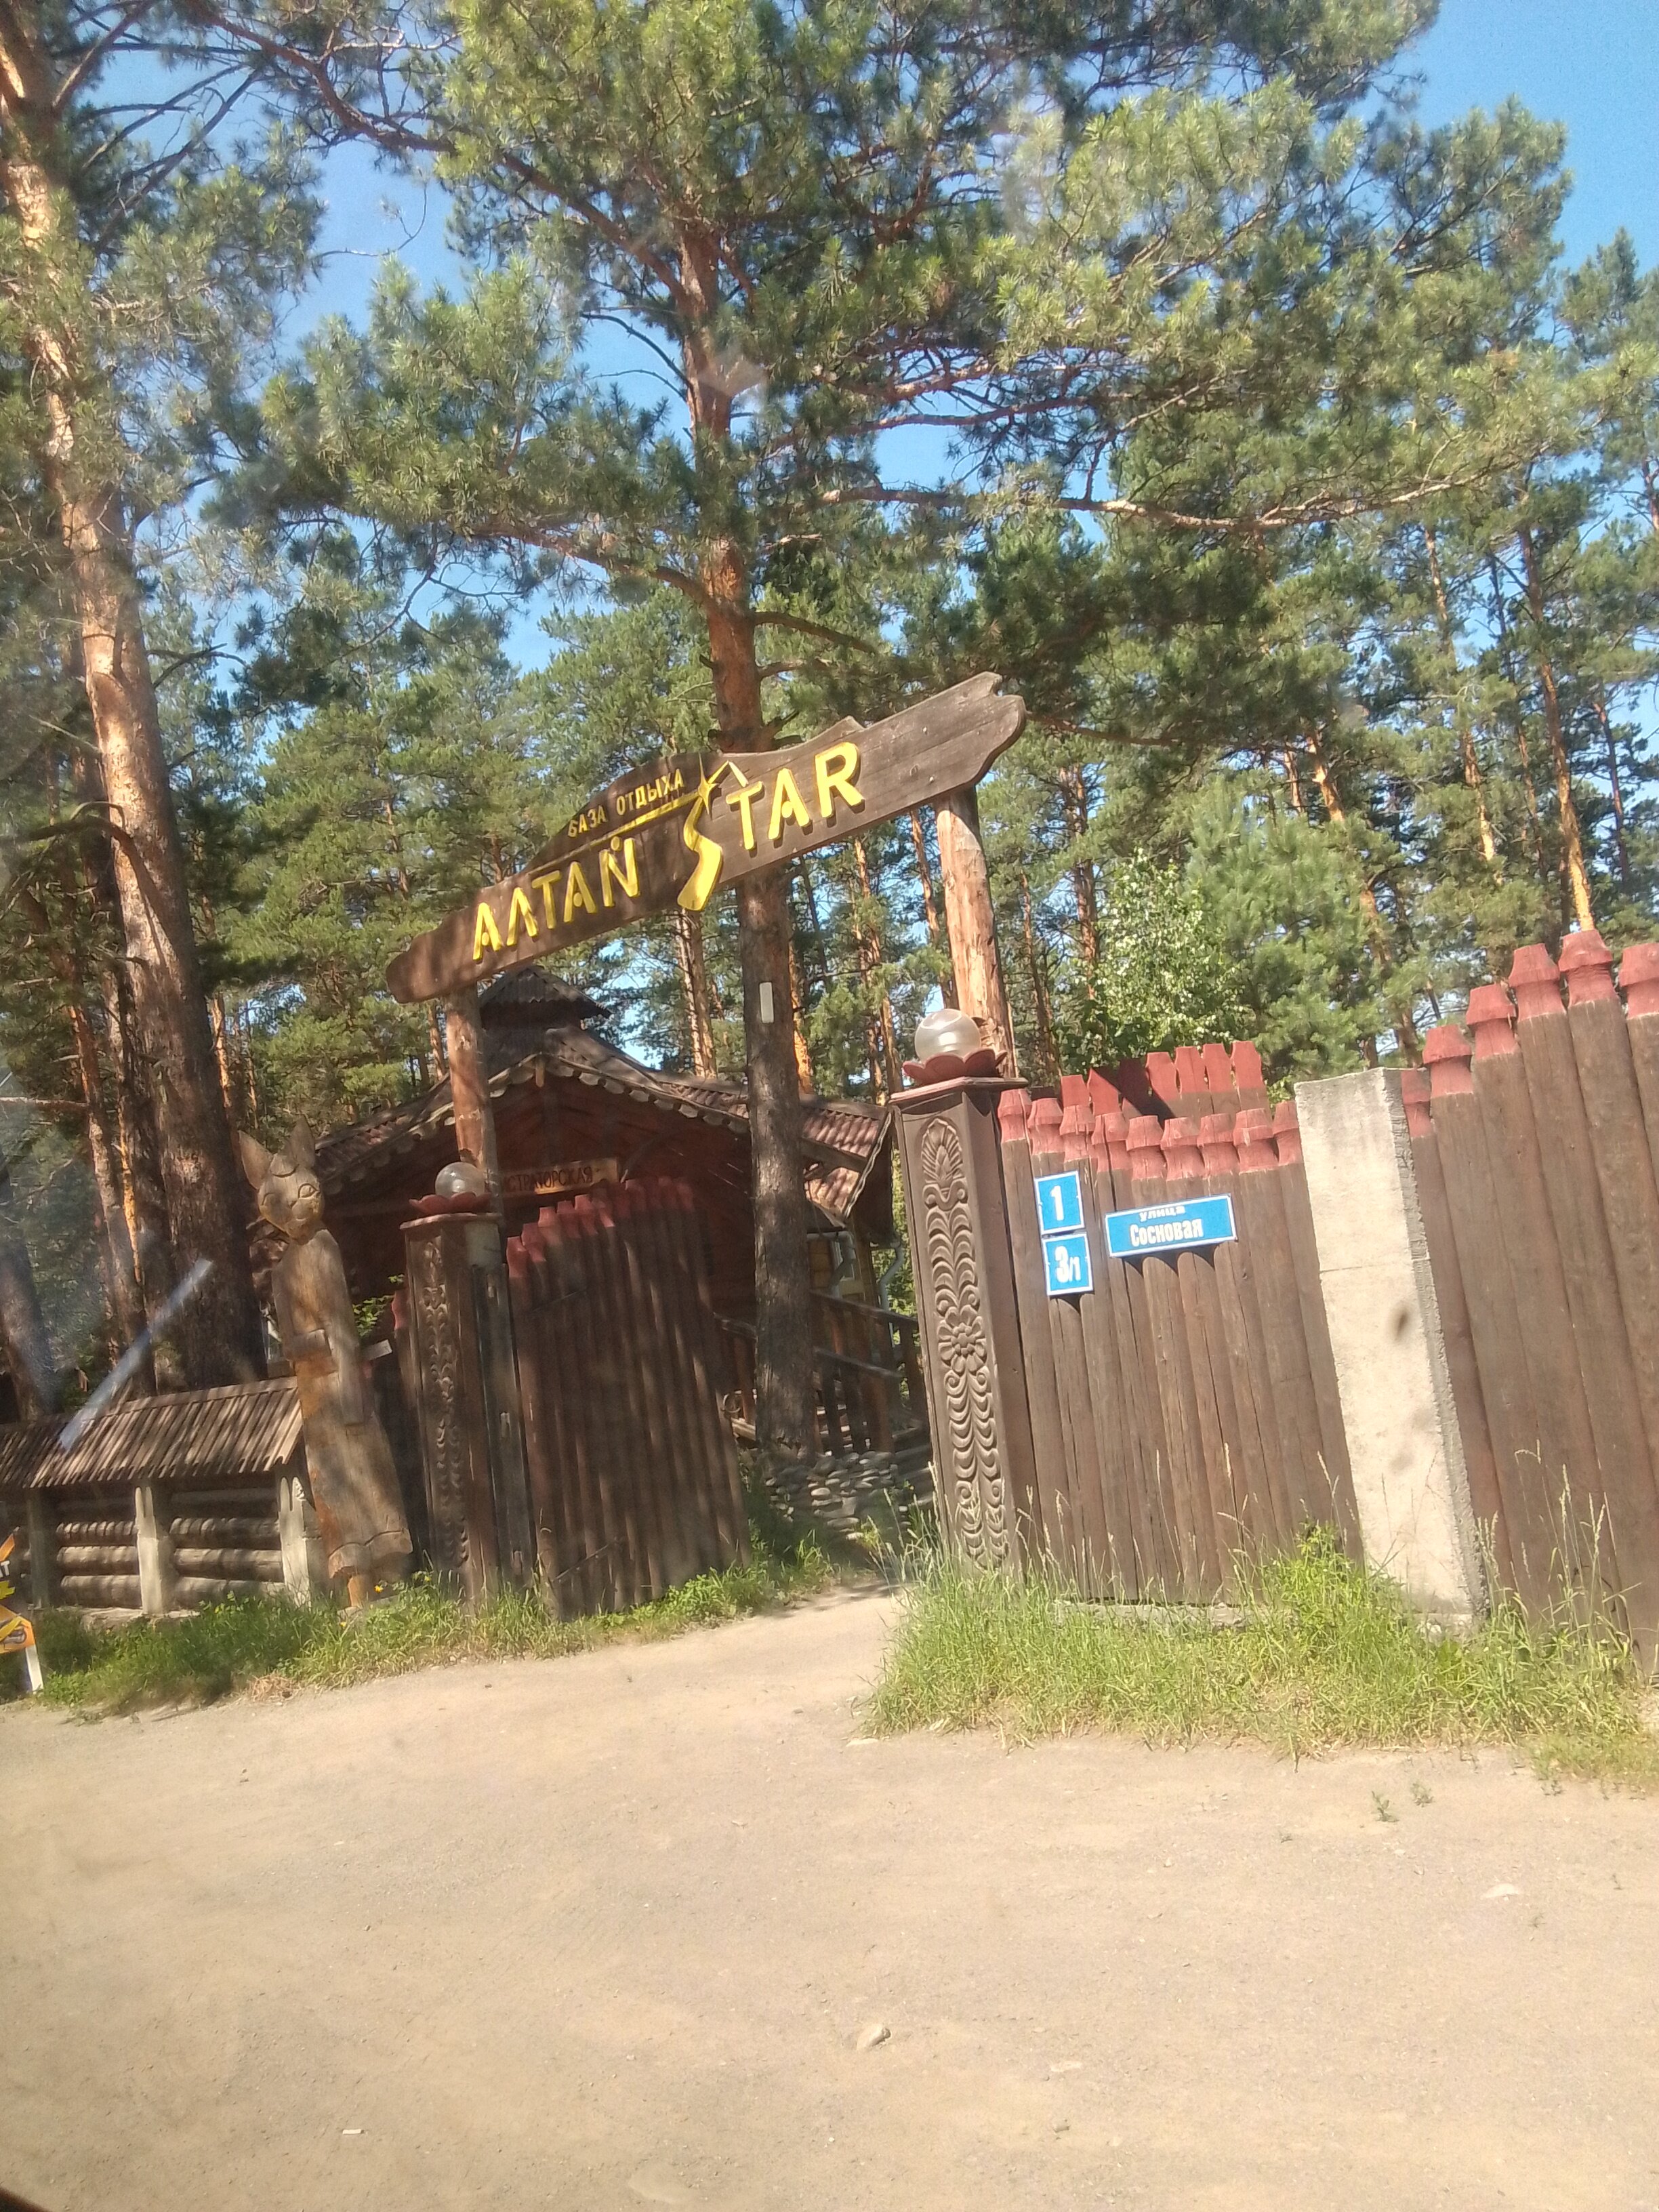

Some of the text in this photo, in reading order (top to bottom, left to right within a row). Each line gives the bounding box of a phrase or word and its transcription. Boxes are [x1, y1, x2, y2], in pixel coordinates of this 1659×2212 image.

[568, 769, 684, 838] БАЗА ОТДЫХА
[677, 742, 865, 911] STAR
[1050, 1185, 1065, 1221] 1
[1139, 1206, 1186, 1222] улица
[1130, 1218, 1204, 1247] Сосновая
